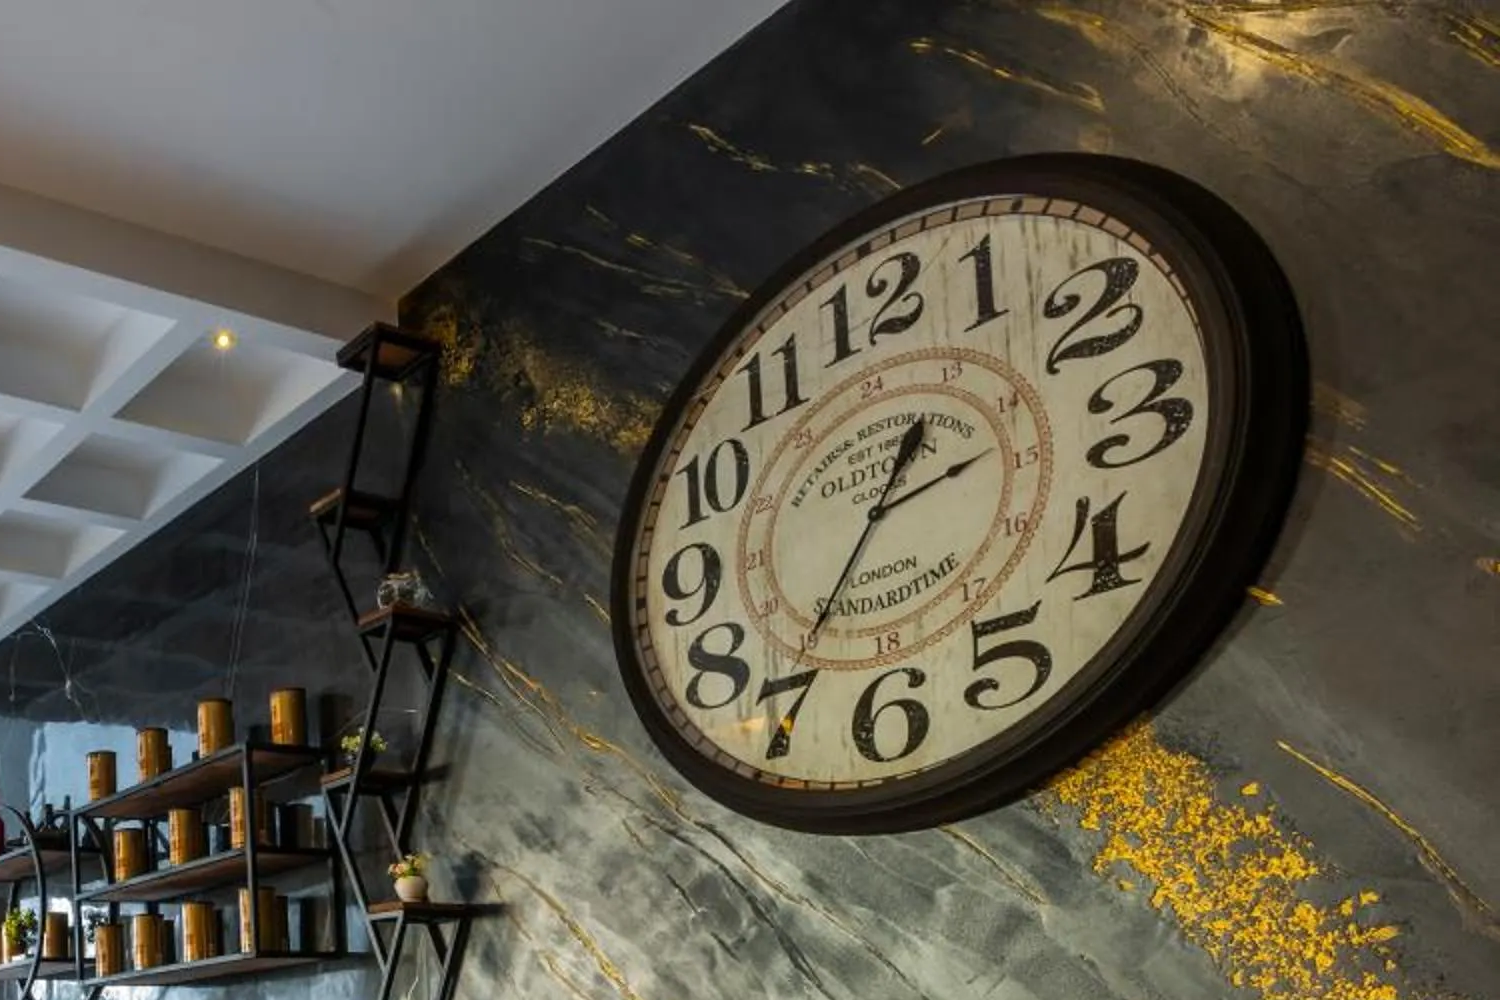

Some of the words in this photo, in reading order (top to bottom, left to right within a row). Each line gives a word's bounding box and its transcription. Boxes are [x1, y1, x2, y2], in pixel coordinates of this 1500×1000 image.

[821, 252, 924, 368] 12
[958, 233, 1010, 332] 1
[1043, 256, 1144, 375] 2
[737, 332, 810, 433] 11
[861, 375, 884, 400] 24
[940, 361, 963, 383] 13
[1086, 358, 1193, 469] 3
[856, 412, 976, 441] RESTORTIONS
[1013, 446, 1039, 470] 15
[675, 438, 750, 531] 10
[1004, 512, 1028, 537] 16
[661, 542, 723, 628] 9
[746, 548, 765, 571] 21
[850, 555, 918, 589] LONDON
[962, 577, 986, 603] 17
[1044, 490, 1151, 602] 4
[684, 622, 751, 710] 8
[874, 631, 900, 655] 18
[964, 599, 1052, 710] 5
[755, 667, 821, 761] 7
[851, 666, 931, 763] 6
